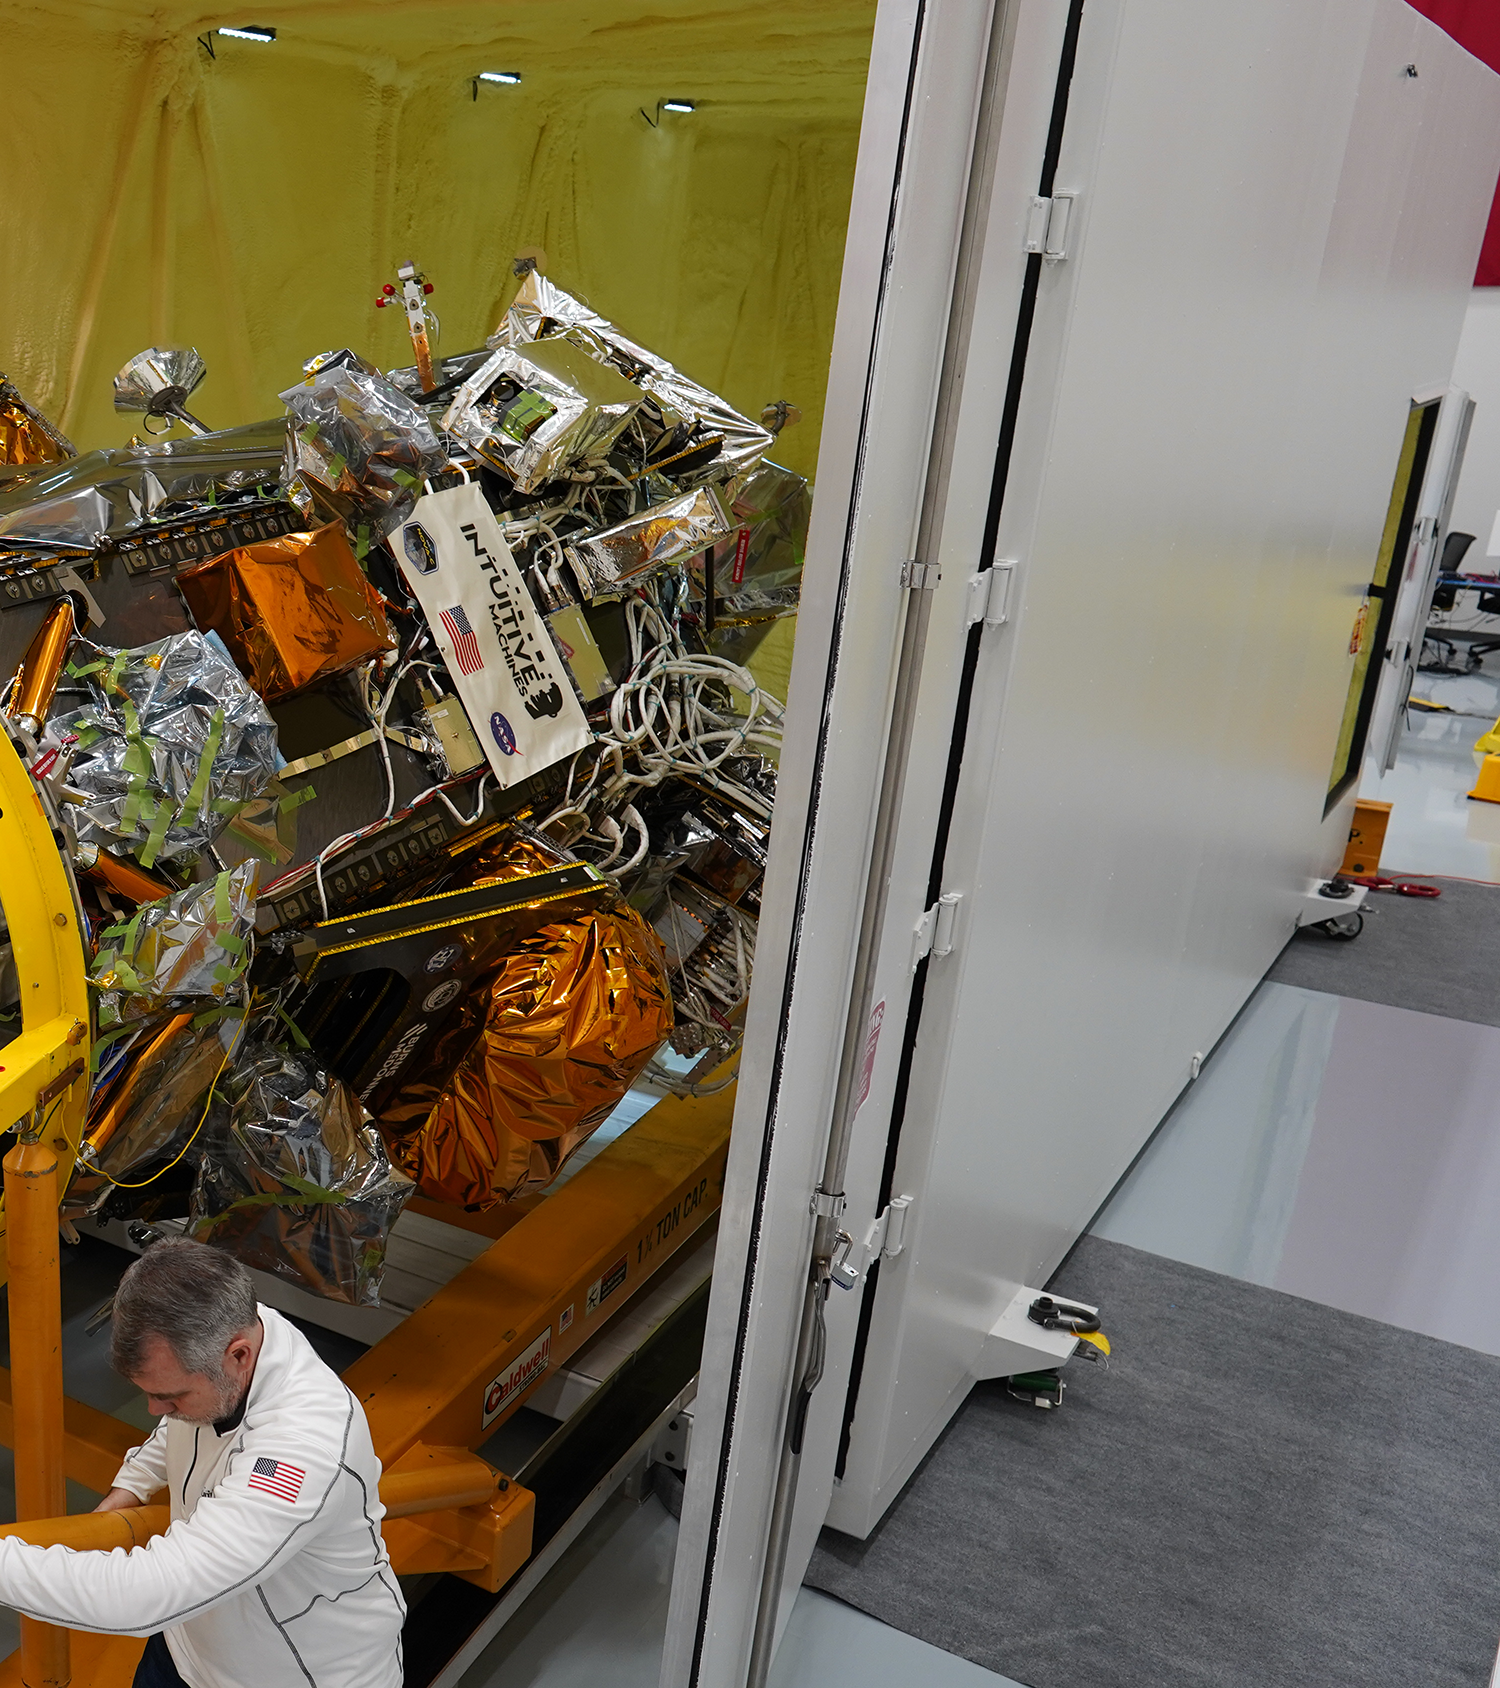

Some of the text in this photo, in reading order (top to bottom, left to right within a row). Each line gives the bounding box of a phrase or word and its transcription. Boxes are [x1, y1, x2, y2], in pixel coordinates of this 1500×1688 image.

[417, 528, 436, 566] NOVA-C
[460, 523, 542, 687] INTUITIVE
[489, 604, 529, 697] MACHINES
[494, 715, 512, 753] NASA
[386, 1036, 421, 1077] BURNS
[656, 1201, 682, 1245] TON
[683, 1177, 708, 1219] CAP.
[485, 1338, 550, 1414] Caldwell
